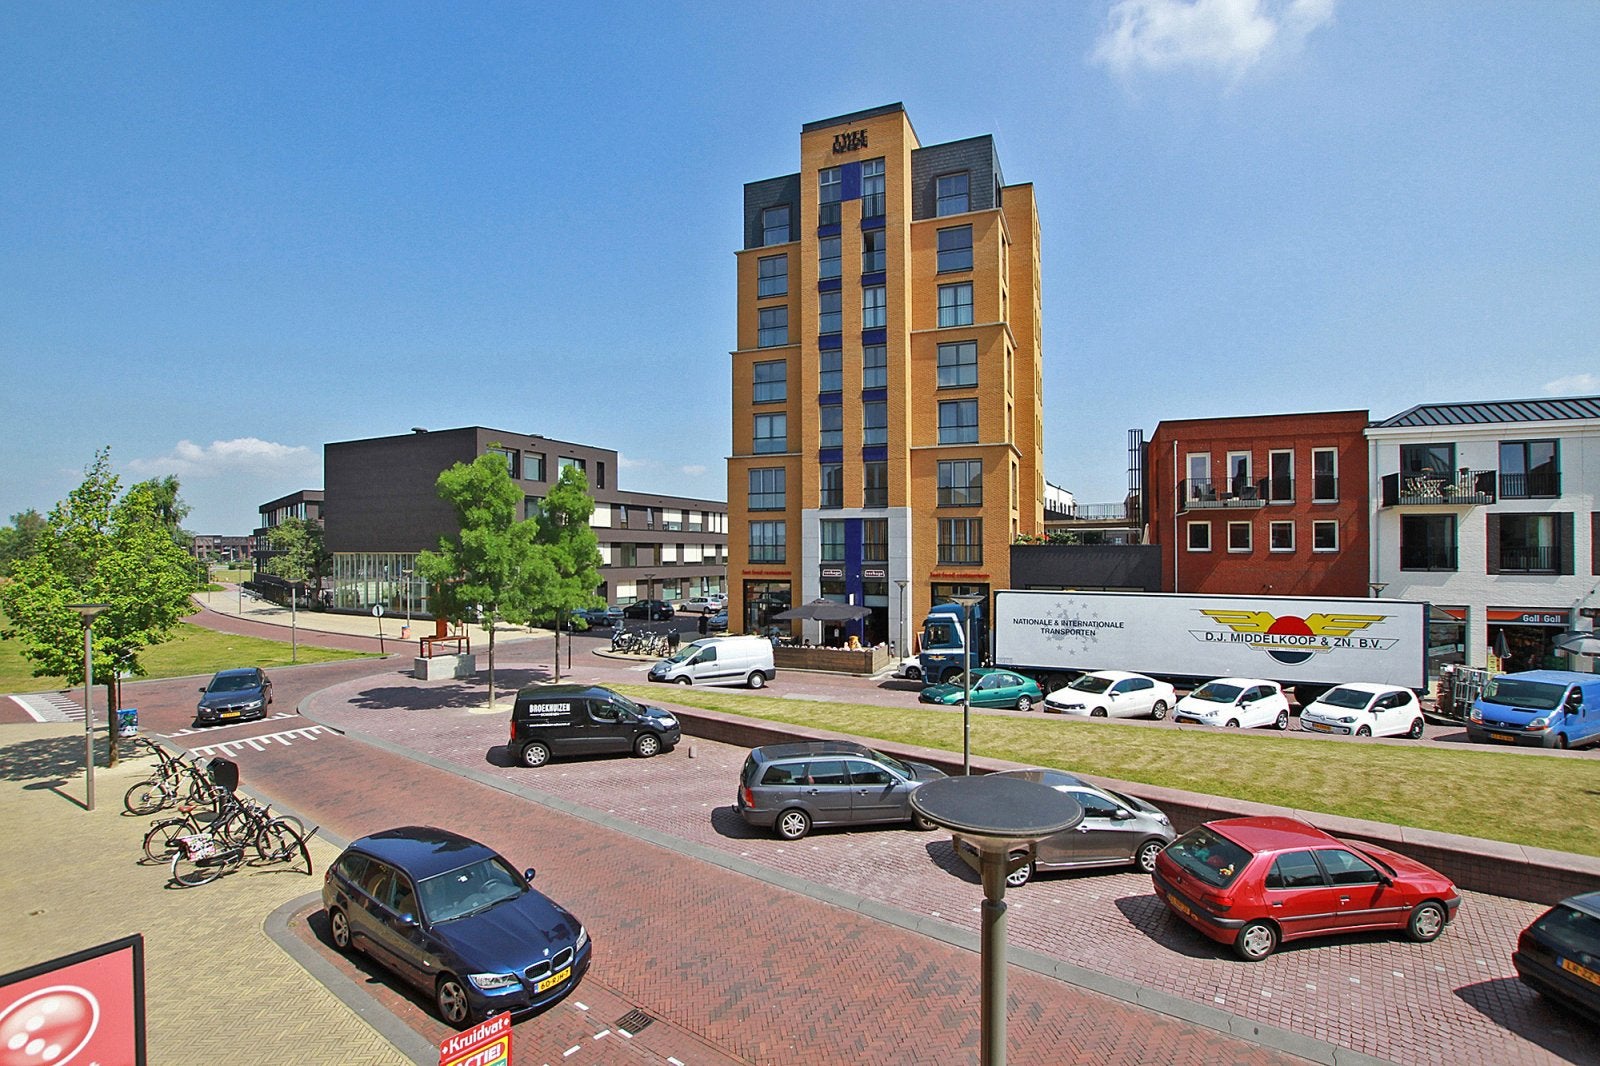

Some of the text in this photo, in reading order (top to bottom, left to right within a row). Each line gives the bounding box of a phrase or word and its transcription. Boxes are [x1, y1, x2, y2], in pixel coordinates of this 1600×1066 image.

[1012, 618, 1053, 626] NATIONALE
[1061, 620, 1125, 629] INTERNATIONALE
[1522, 614, 1561, 623] Gall Gall
[1041, 628, 1096, 636] TRANSPORTEN
[1205, 632, 1382, 649] D.J. MIDDELKOOP & ZN. B.V.
[529, 703, 571, 712] BROEKHUIZEN
[449, 1018, 503, 1054] Kruidvat
[456, 1043, 502, 1066] CTIE!
